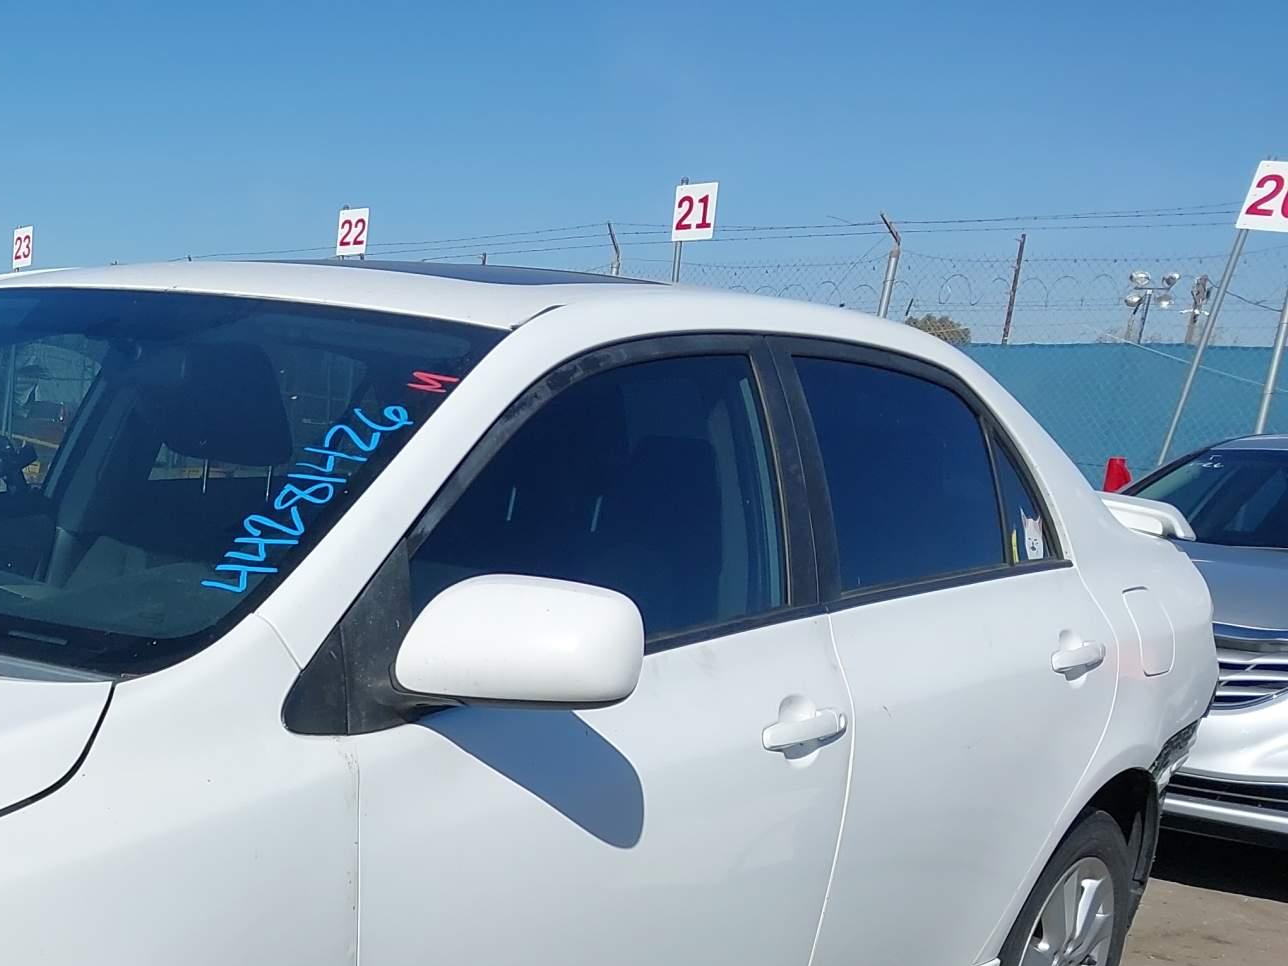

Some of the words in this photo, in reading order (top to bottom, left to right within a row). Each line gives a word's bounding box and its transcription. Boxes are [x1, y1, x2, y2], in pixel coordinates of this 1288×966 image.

[675, 194, 711, 231] 21
[1245, 174, 1288, 219] 2
[14, 234, 31, 260] 23
[339, 218, 366, 247] 22
[200, 405, 414, 592] 44281426
